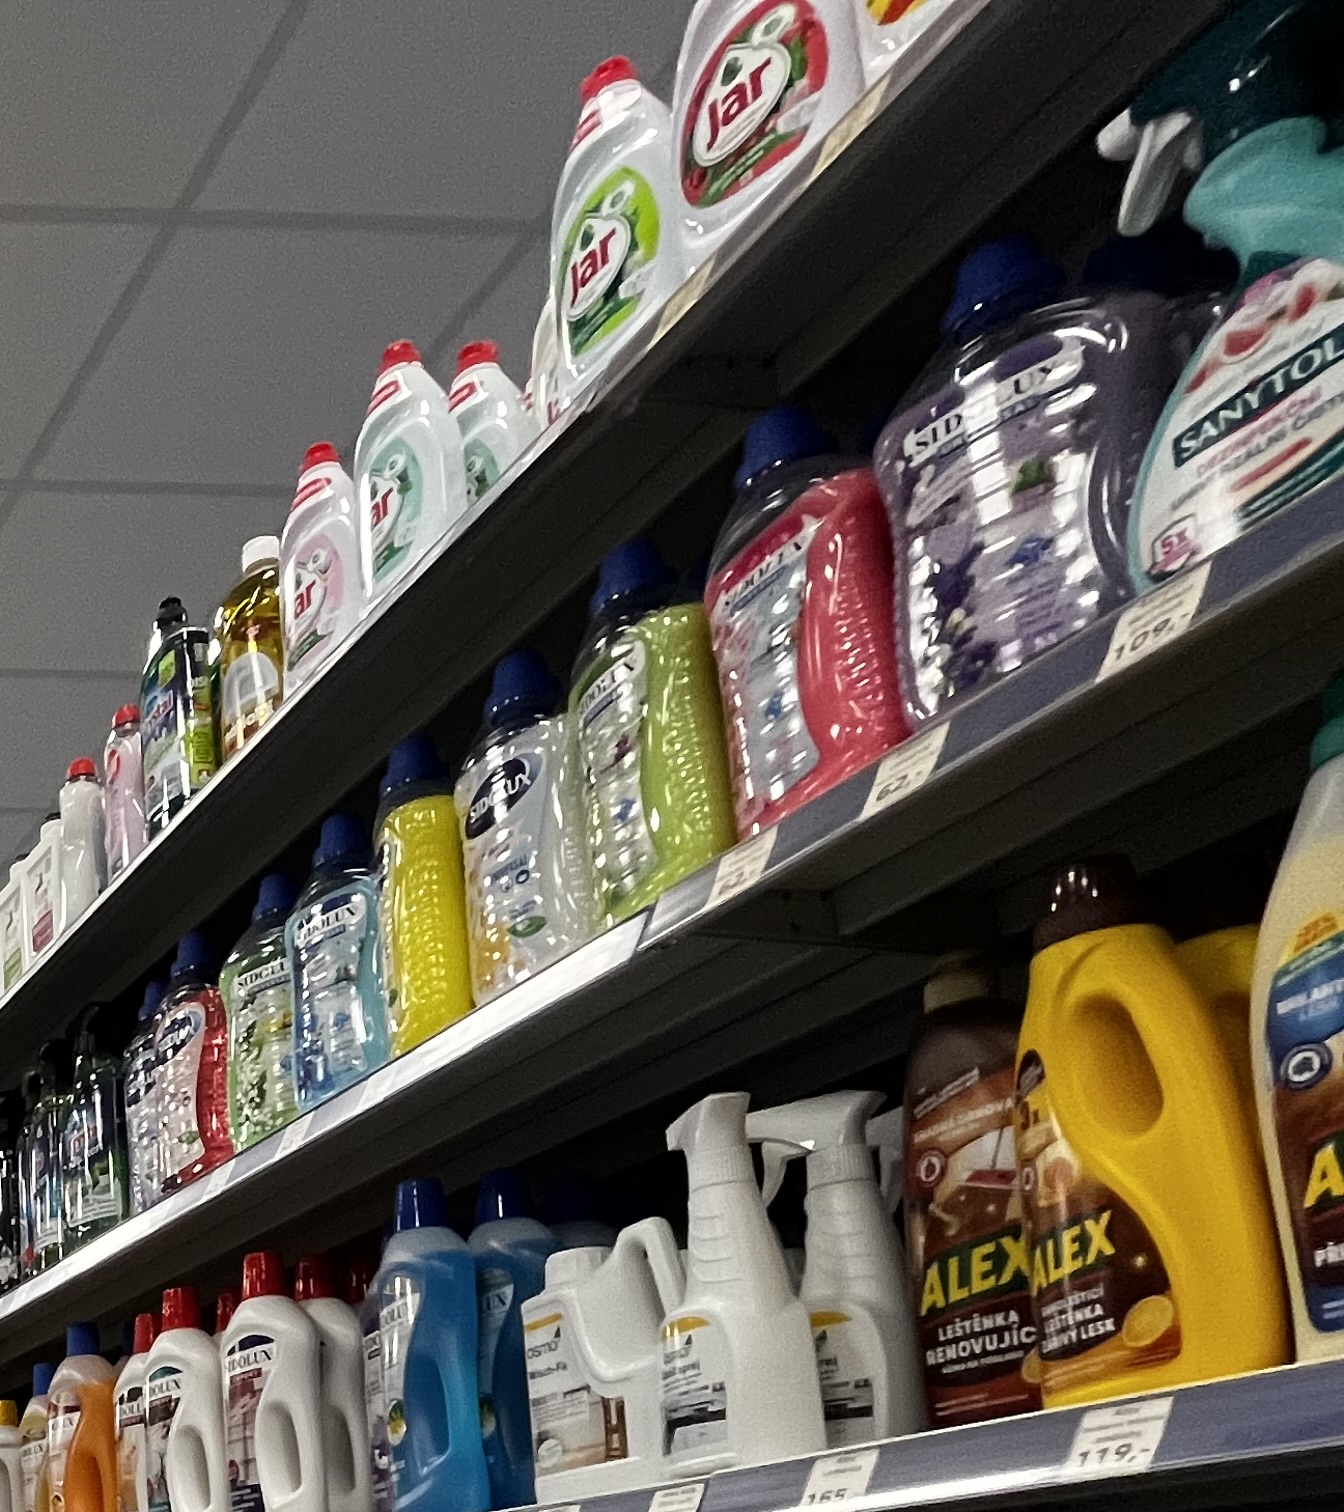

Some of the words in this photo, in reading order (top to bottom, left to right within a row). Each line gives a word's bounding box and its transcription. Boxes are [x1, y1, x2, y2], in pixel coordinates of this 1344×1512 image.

[237, 961, 287, 989] SIDOLU
[919, 1234, 1032, 1316] ALEX
[1031, 1210, 1116, 1296] ALEX
[925, 1323, 1039, 1367] RENOVUJÍC
